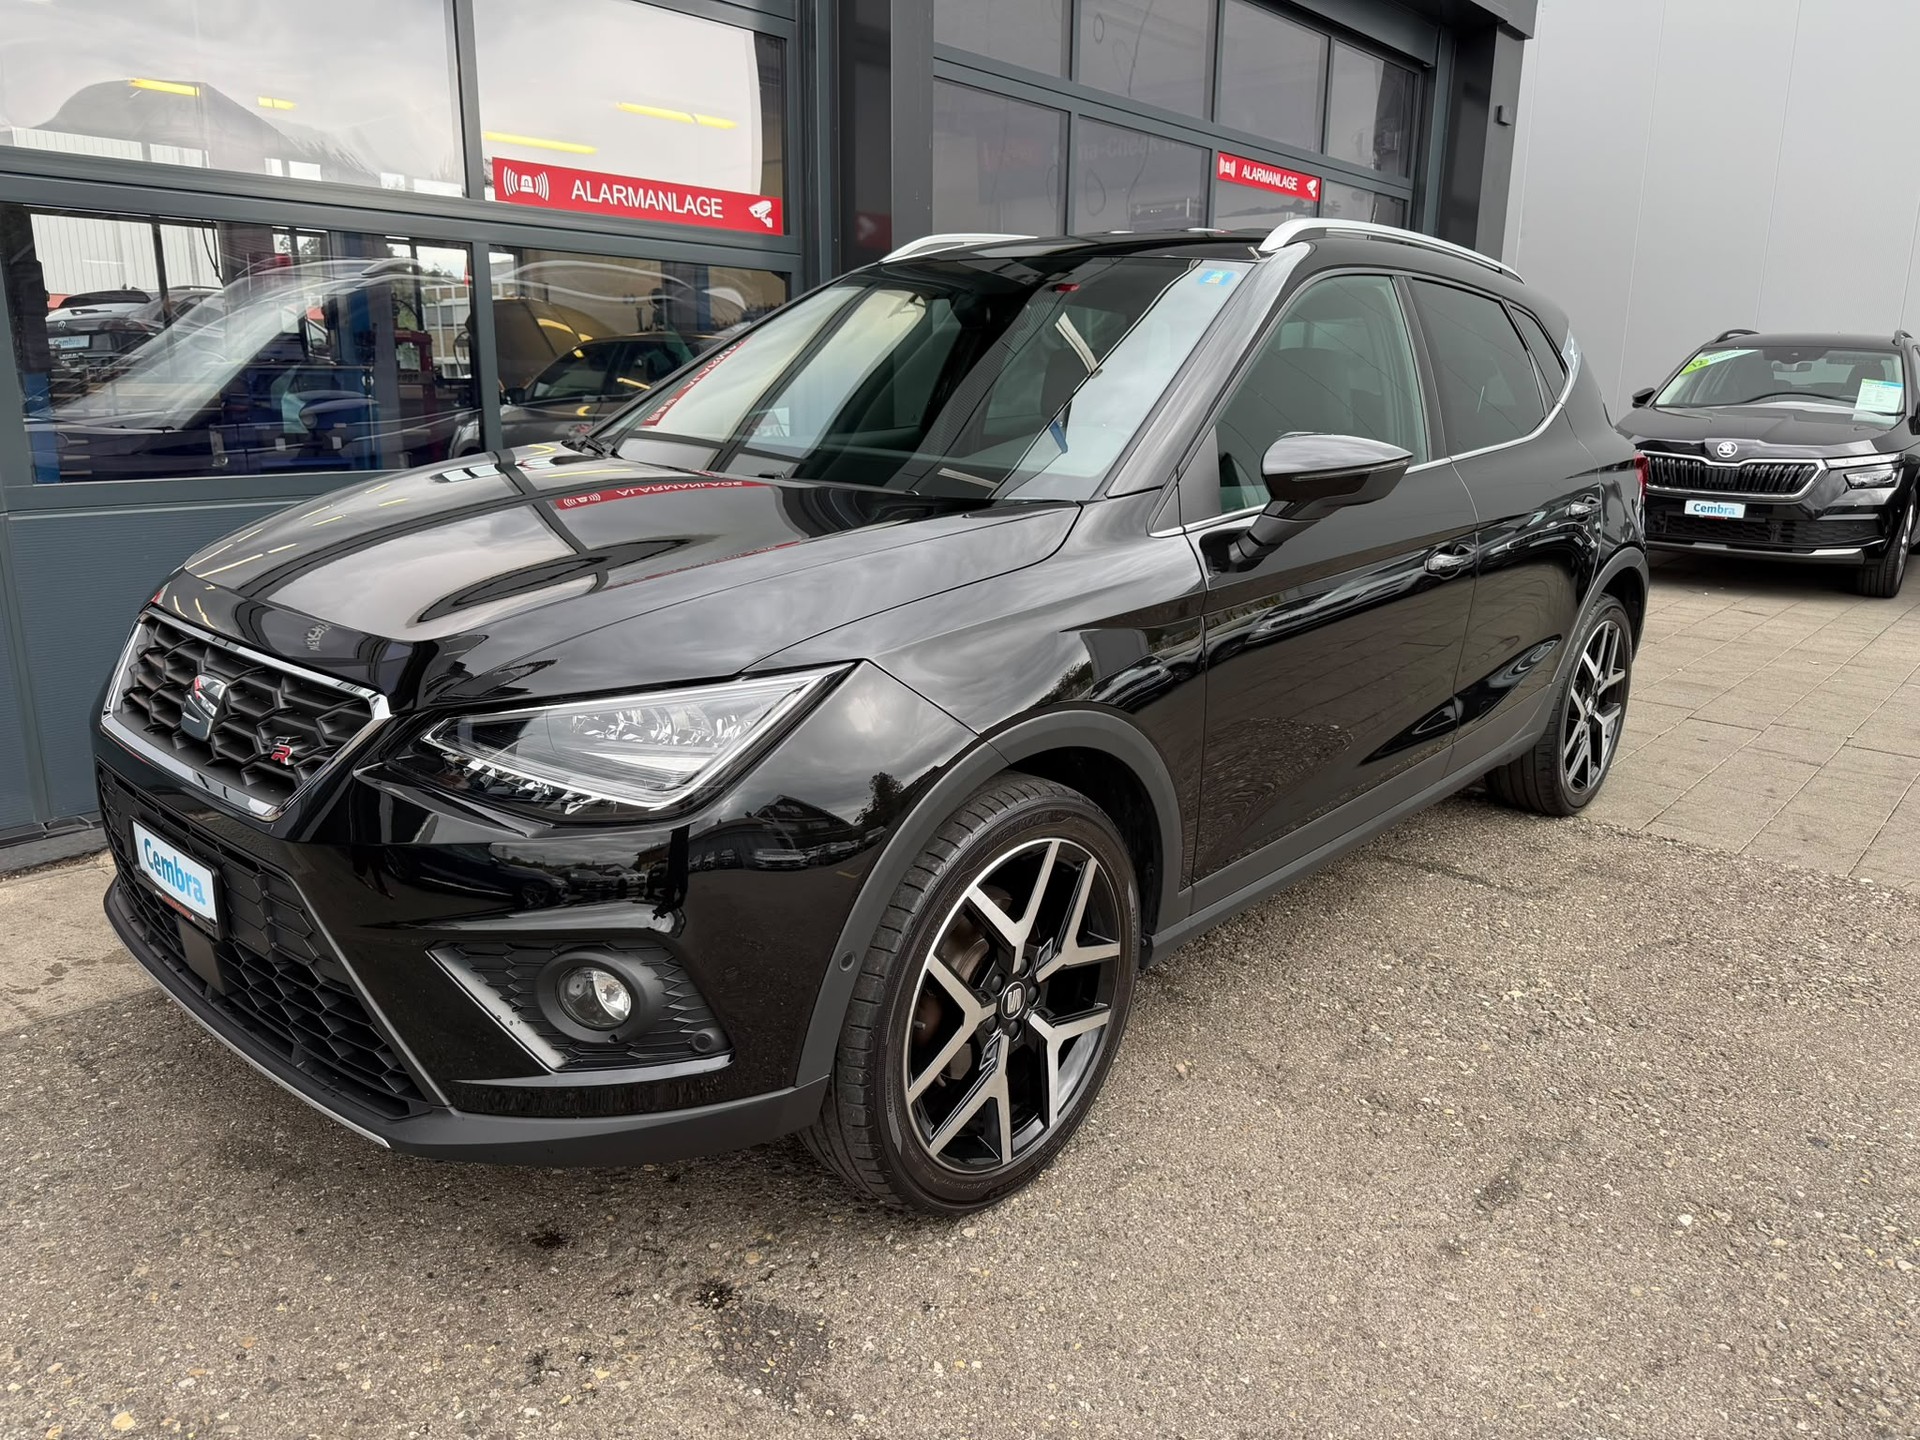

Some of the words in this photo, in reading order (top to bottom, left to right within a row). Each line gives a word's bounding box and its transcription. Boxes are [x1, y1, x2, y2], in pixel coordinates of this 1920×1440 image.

[1241, 164, 1298, 191] ALARMANLAGE
[571, 179, 724, 219] ALARMANLAGE
[1693, 503, 1736, 515] Cembra
[144, 838, 206, 905] Cembra
